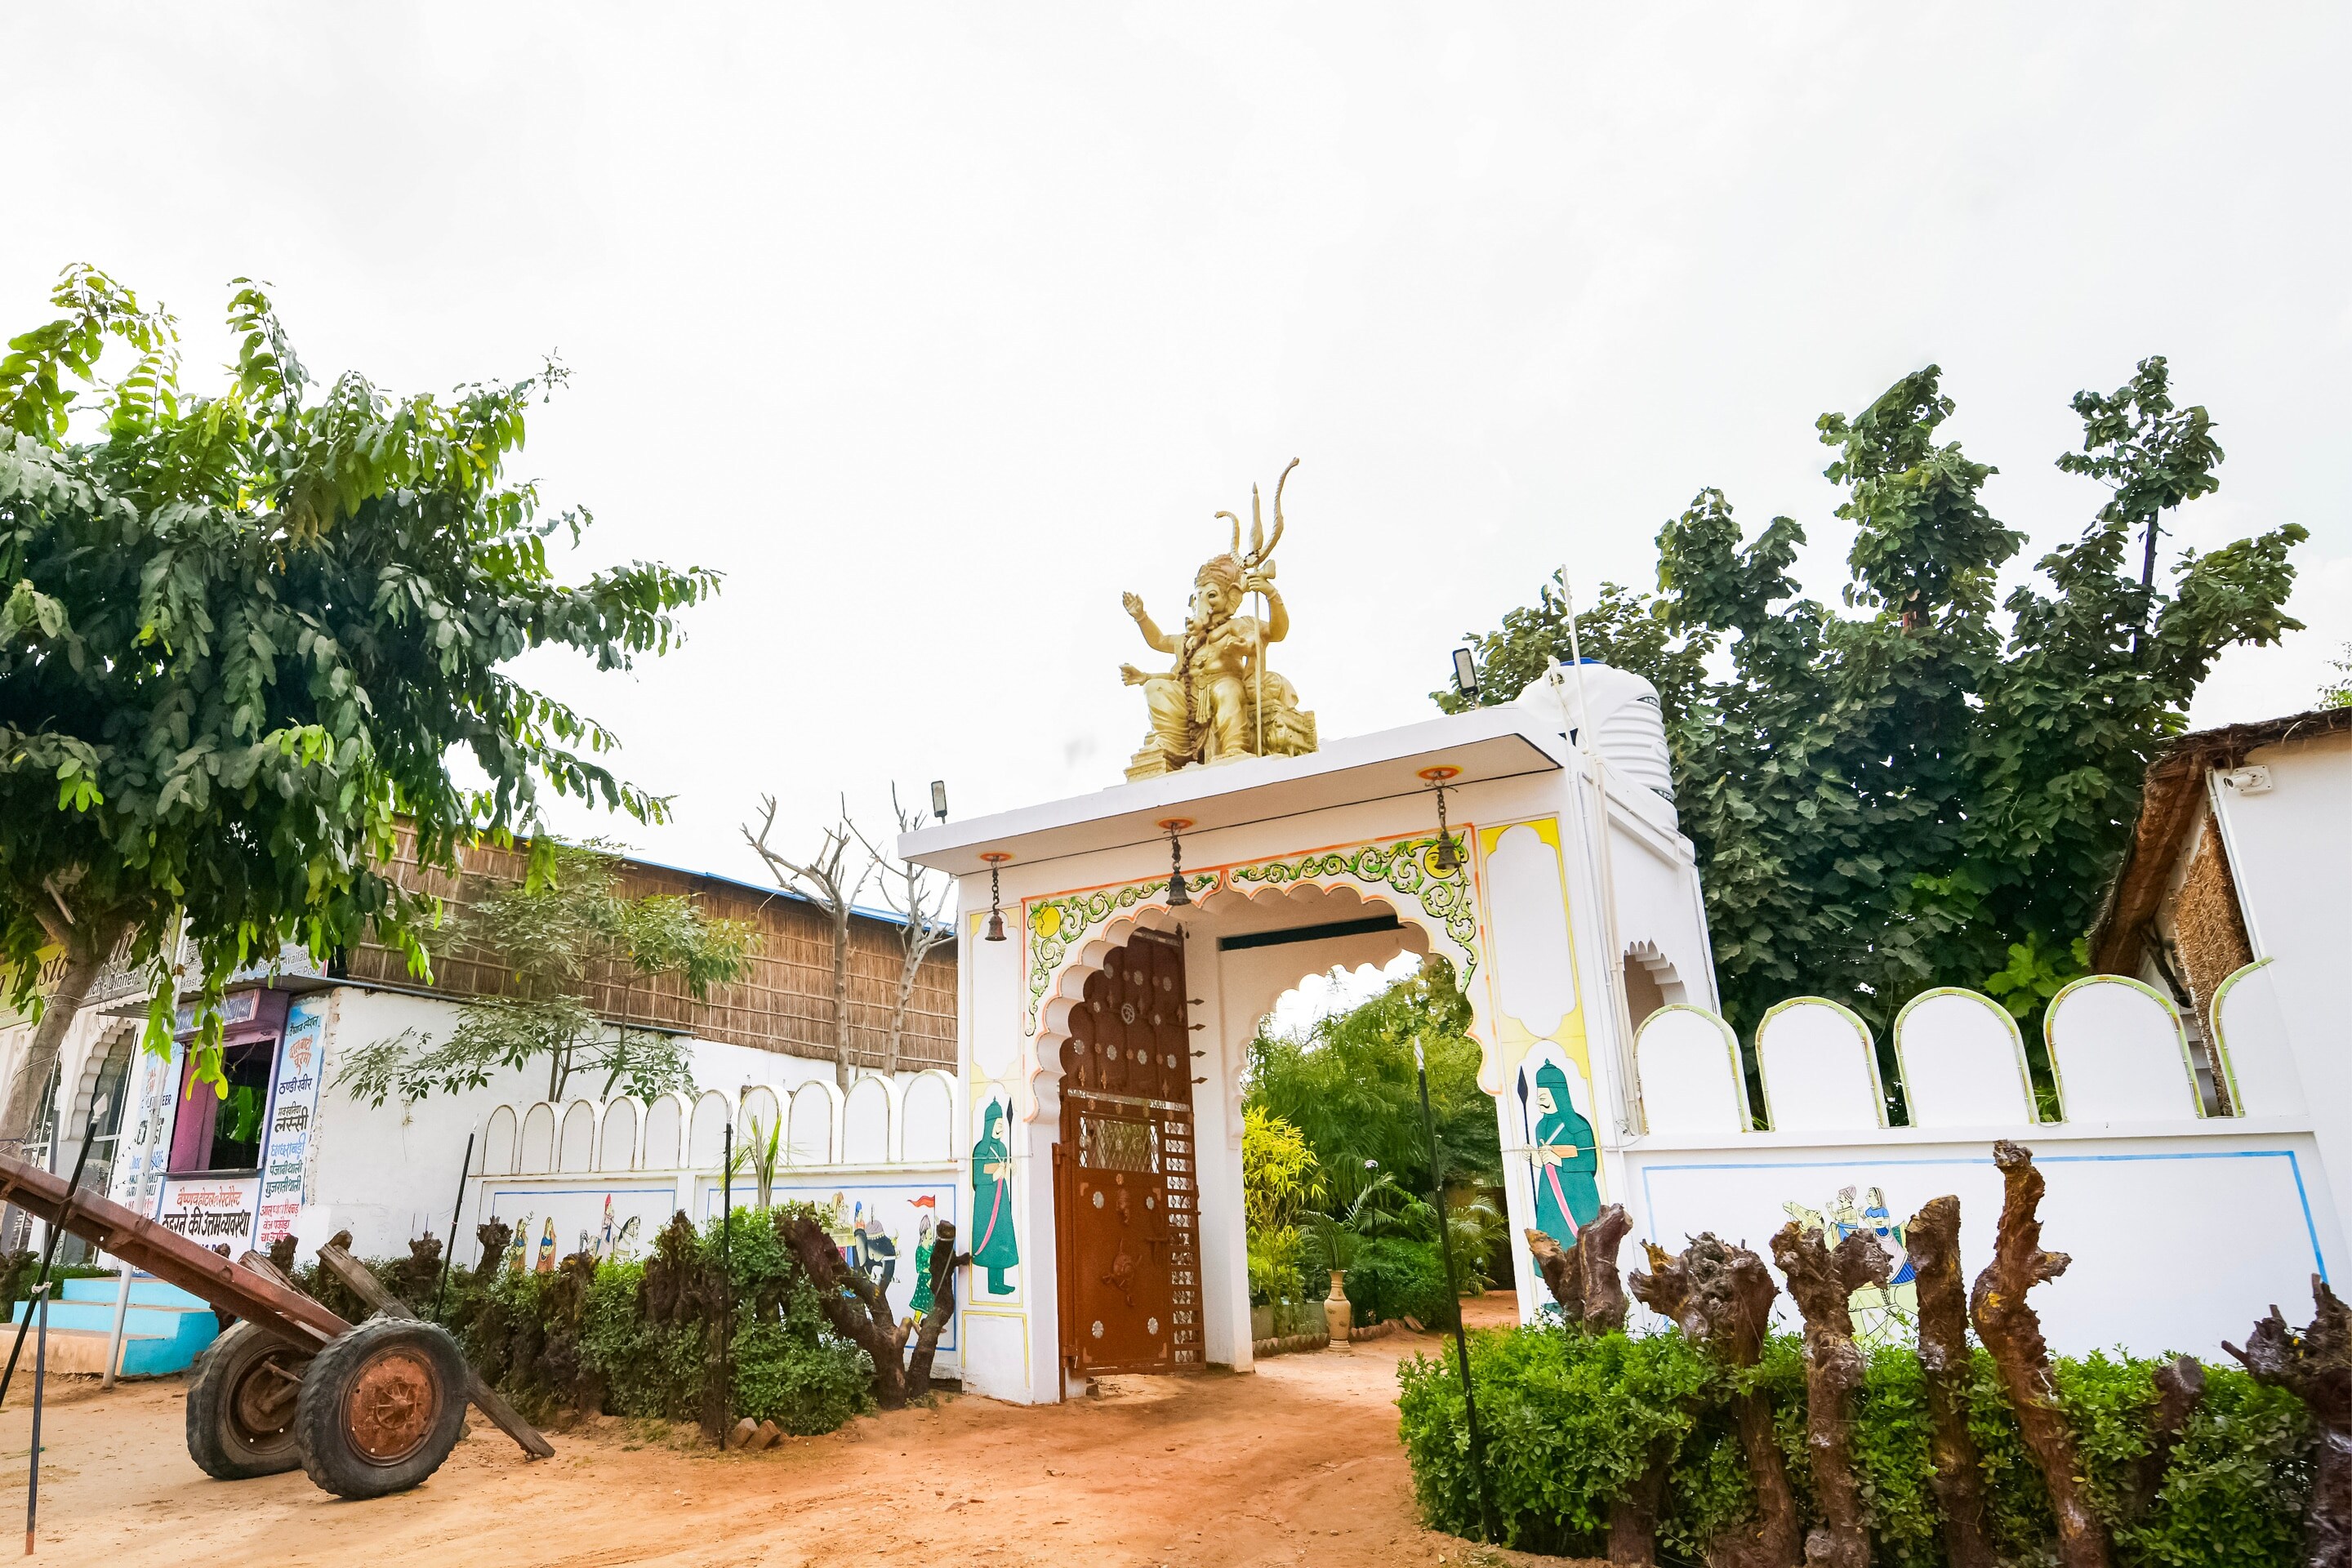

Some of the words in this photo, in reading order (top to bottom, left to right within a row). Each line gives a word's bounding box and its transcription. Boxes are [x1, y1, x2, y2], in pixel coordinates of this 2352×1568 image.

[282, 951, 310, 966] Availab
[274, 1106, 310, 1134] लस्सी
[188, 1205, 203, 1236] की
